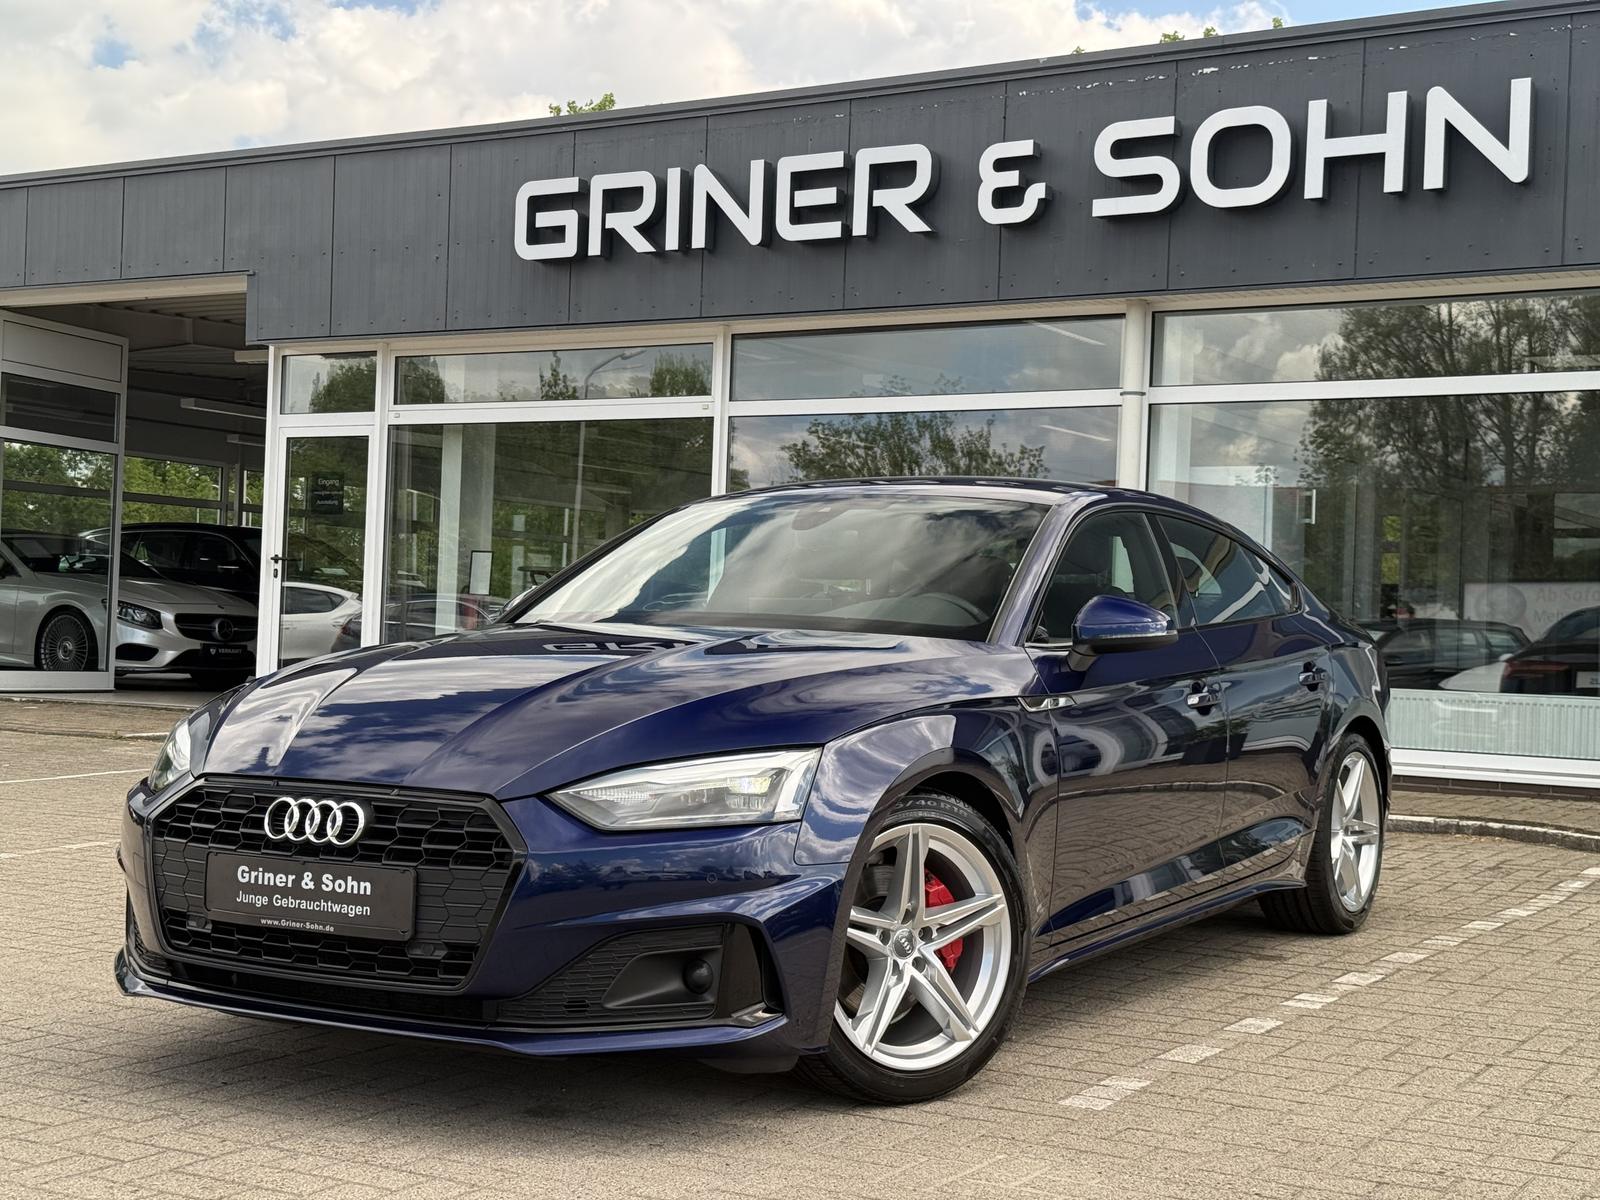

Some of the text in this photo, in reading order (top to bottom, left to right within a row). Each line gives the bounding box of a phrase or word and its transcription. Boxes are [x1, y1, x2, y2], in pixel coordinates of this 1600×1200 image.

[514, 77, 1533, 261] GRINER & SOHN
[237, 865, 371, 896] Griner & Sohn
[236, 890, 371, 917] Junge Gebrauchtwagen
[260, 917, 335, 932] www.Griner-Sohn.de
